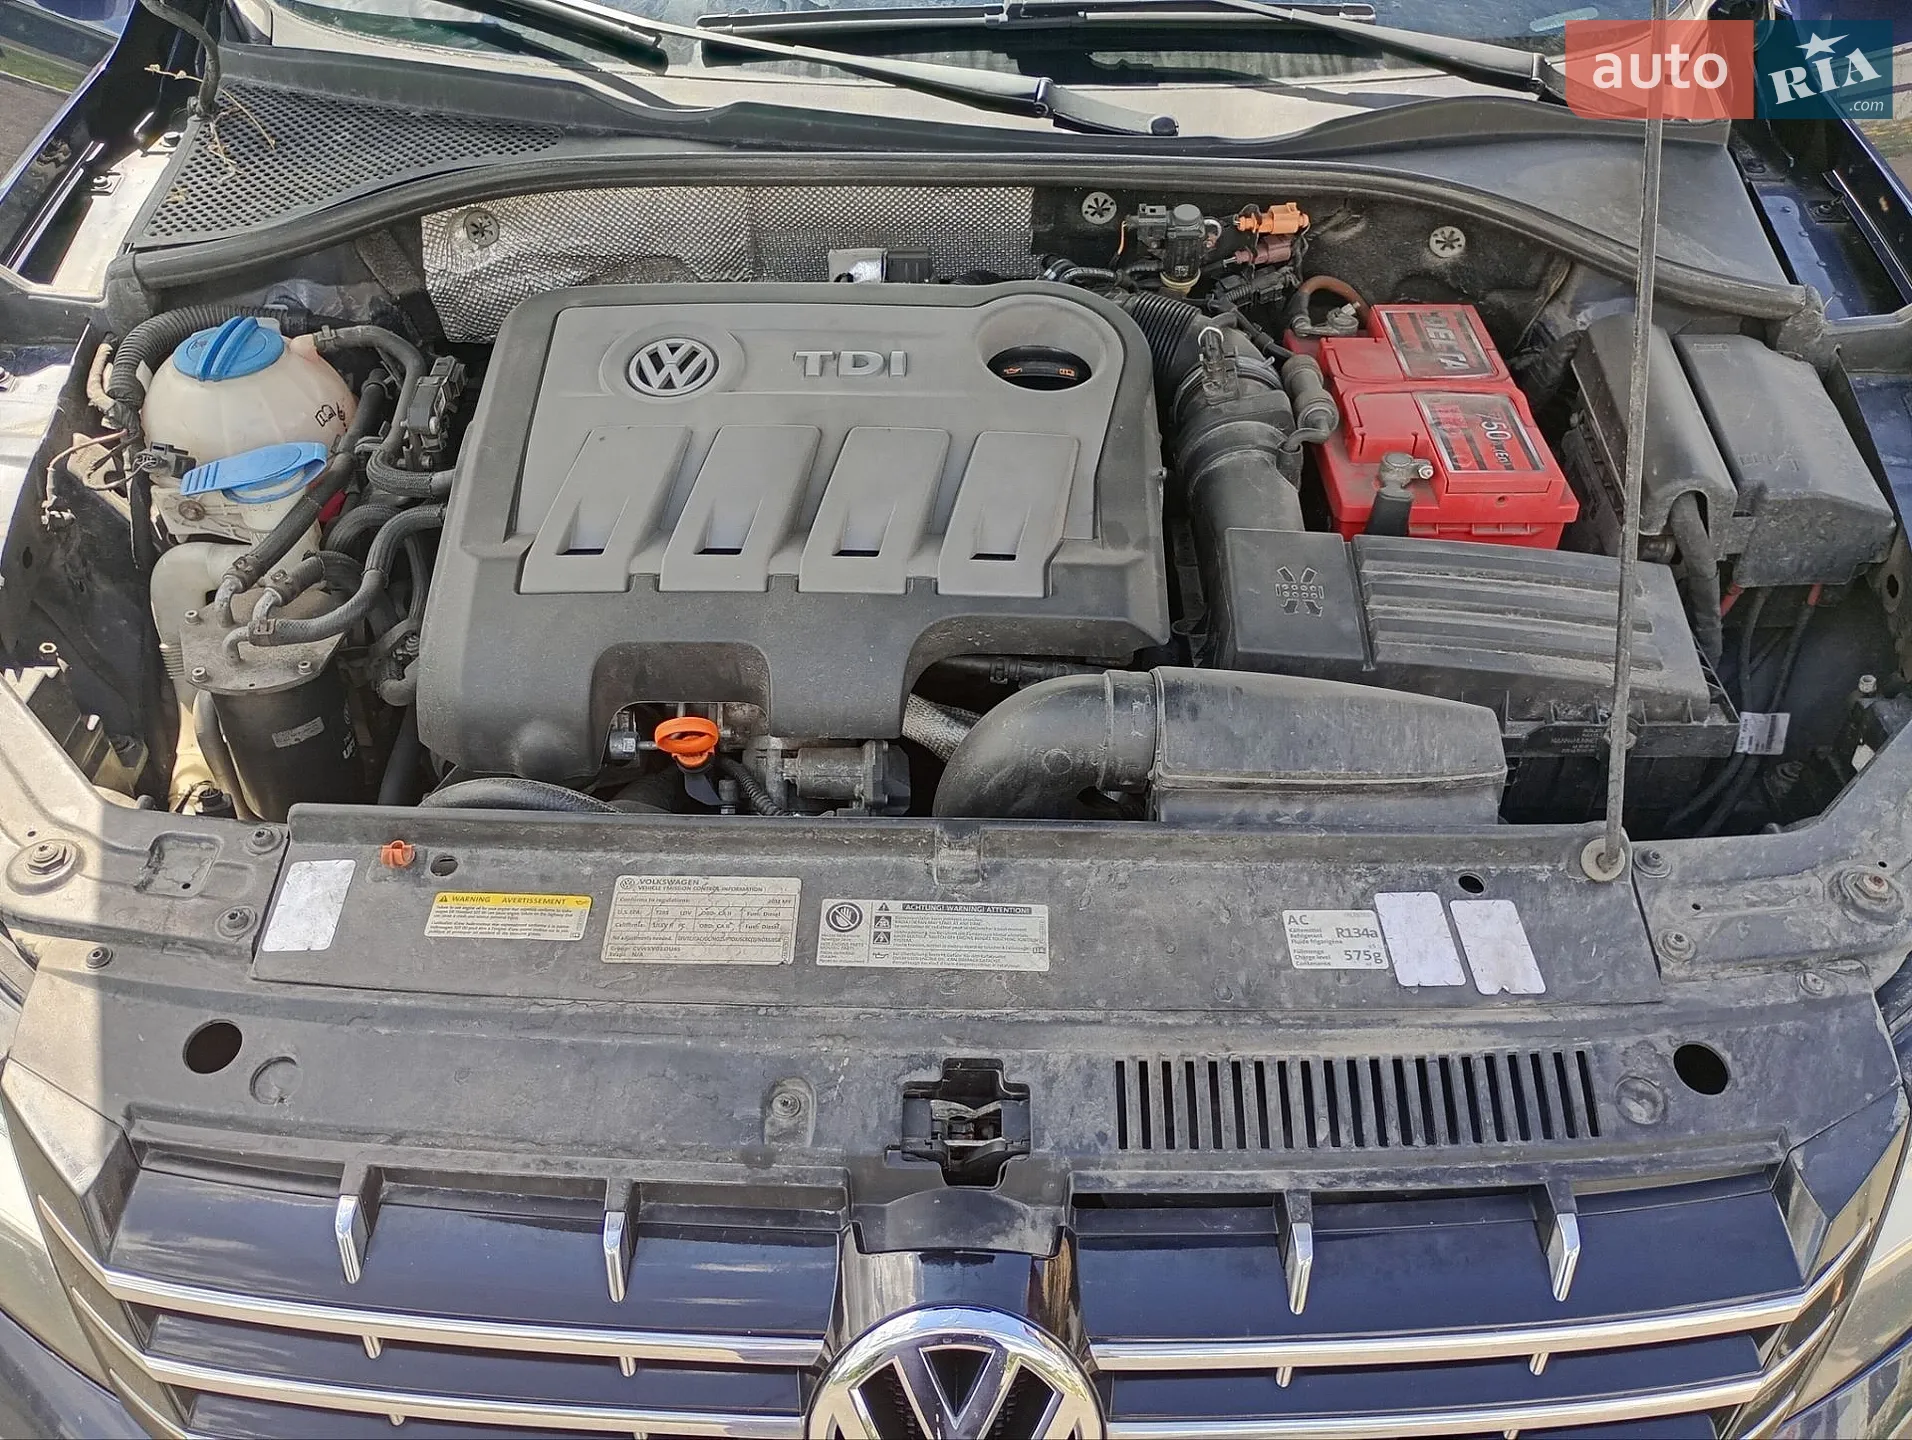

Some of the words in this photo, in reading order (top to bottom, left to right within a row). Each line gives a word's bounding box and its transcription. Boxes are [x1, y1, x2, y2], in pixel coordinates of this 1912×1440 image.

[794, 350, 907, 377] TDI
[639, 878, 700, 886] VOLKSWAGEN
[502, 897, 566, 905] AVERTISSEMENT
[986, 906, 1031, 914] ATTENTION!
[1288, 914, 1309, 925] AC
[1335, 927, 1379, 938] R134a
